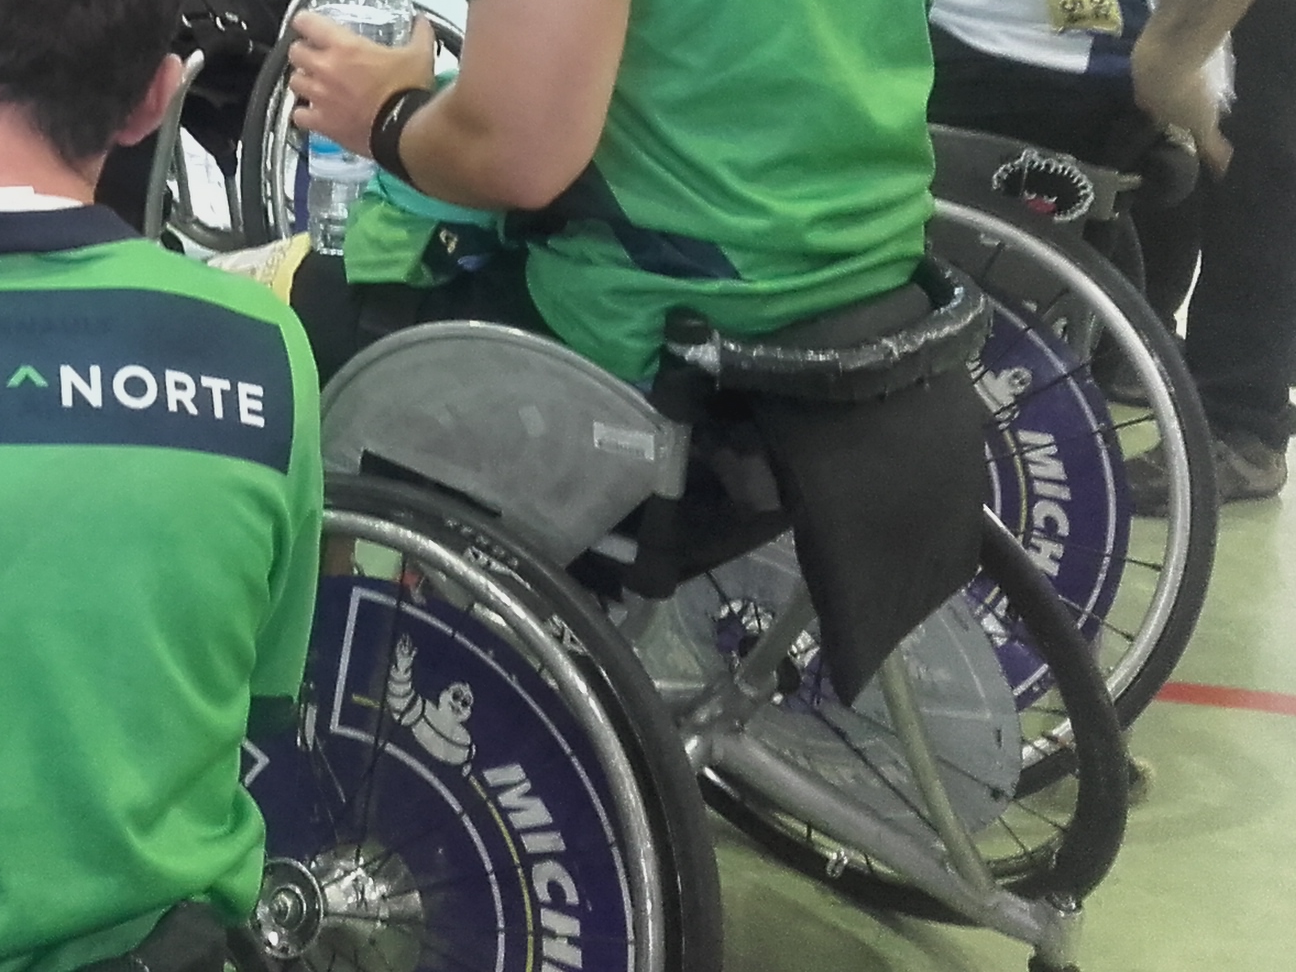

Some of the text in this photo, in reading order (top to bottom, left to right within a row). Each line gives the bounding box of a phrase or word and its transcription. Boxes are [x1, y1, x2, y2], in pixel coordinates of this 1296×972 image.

[60, 364, 266, 428] NORTE
[1016, 429, 1072, 577] MICH
[482, 763, 583, 972] MICH
